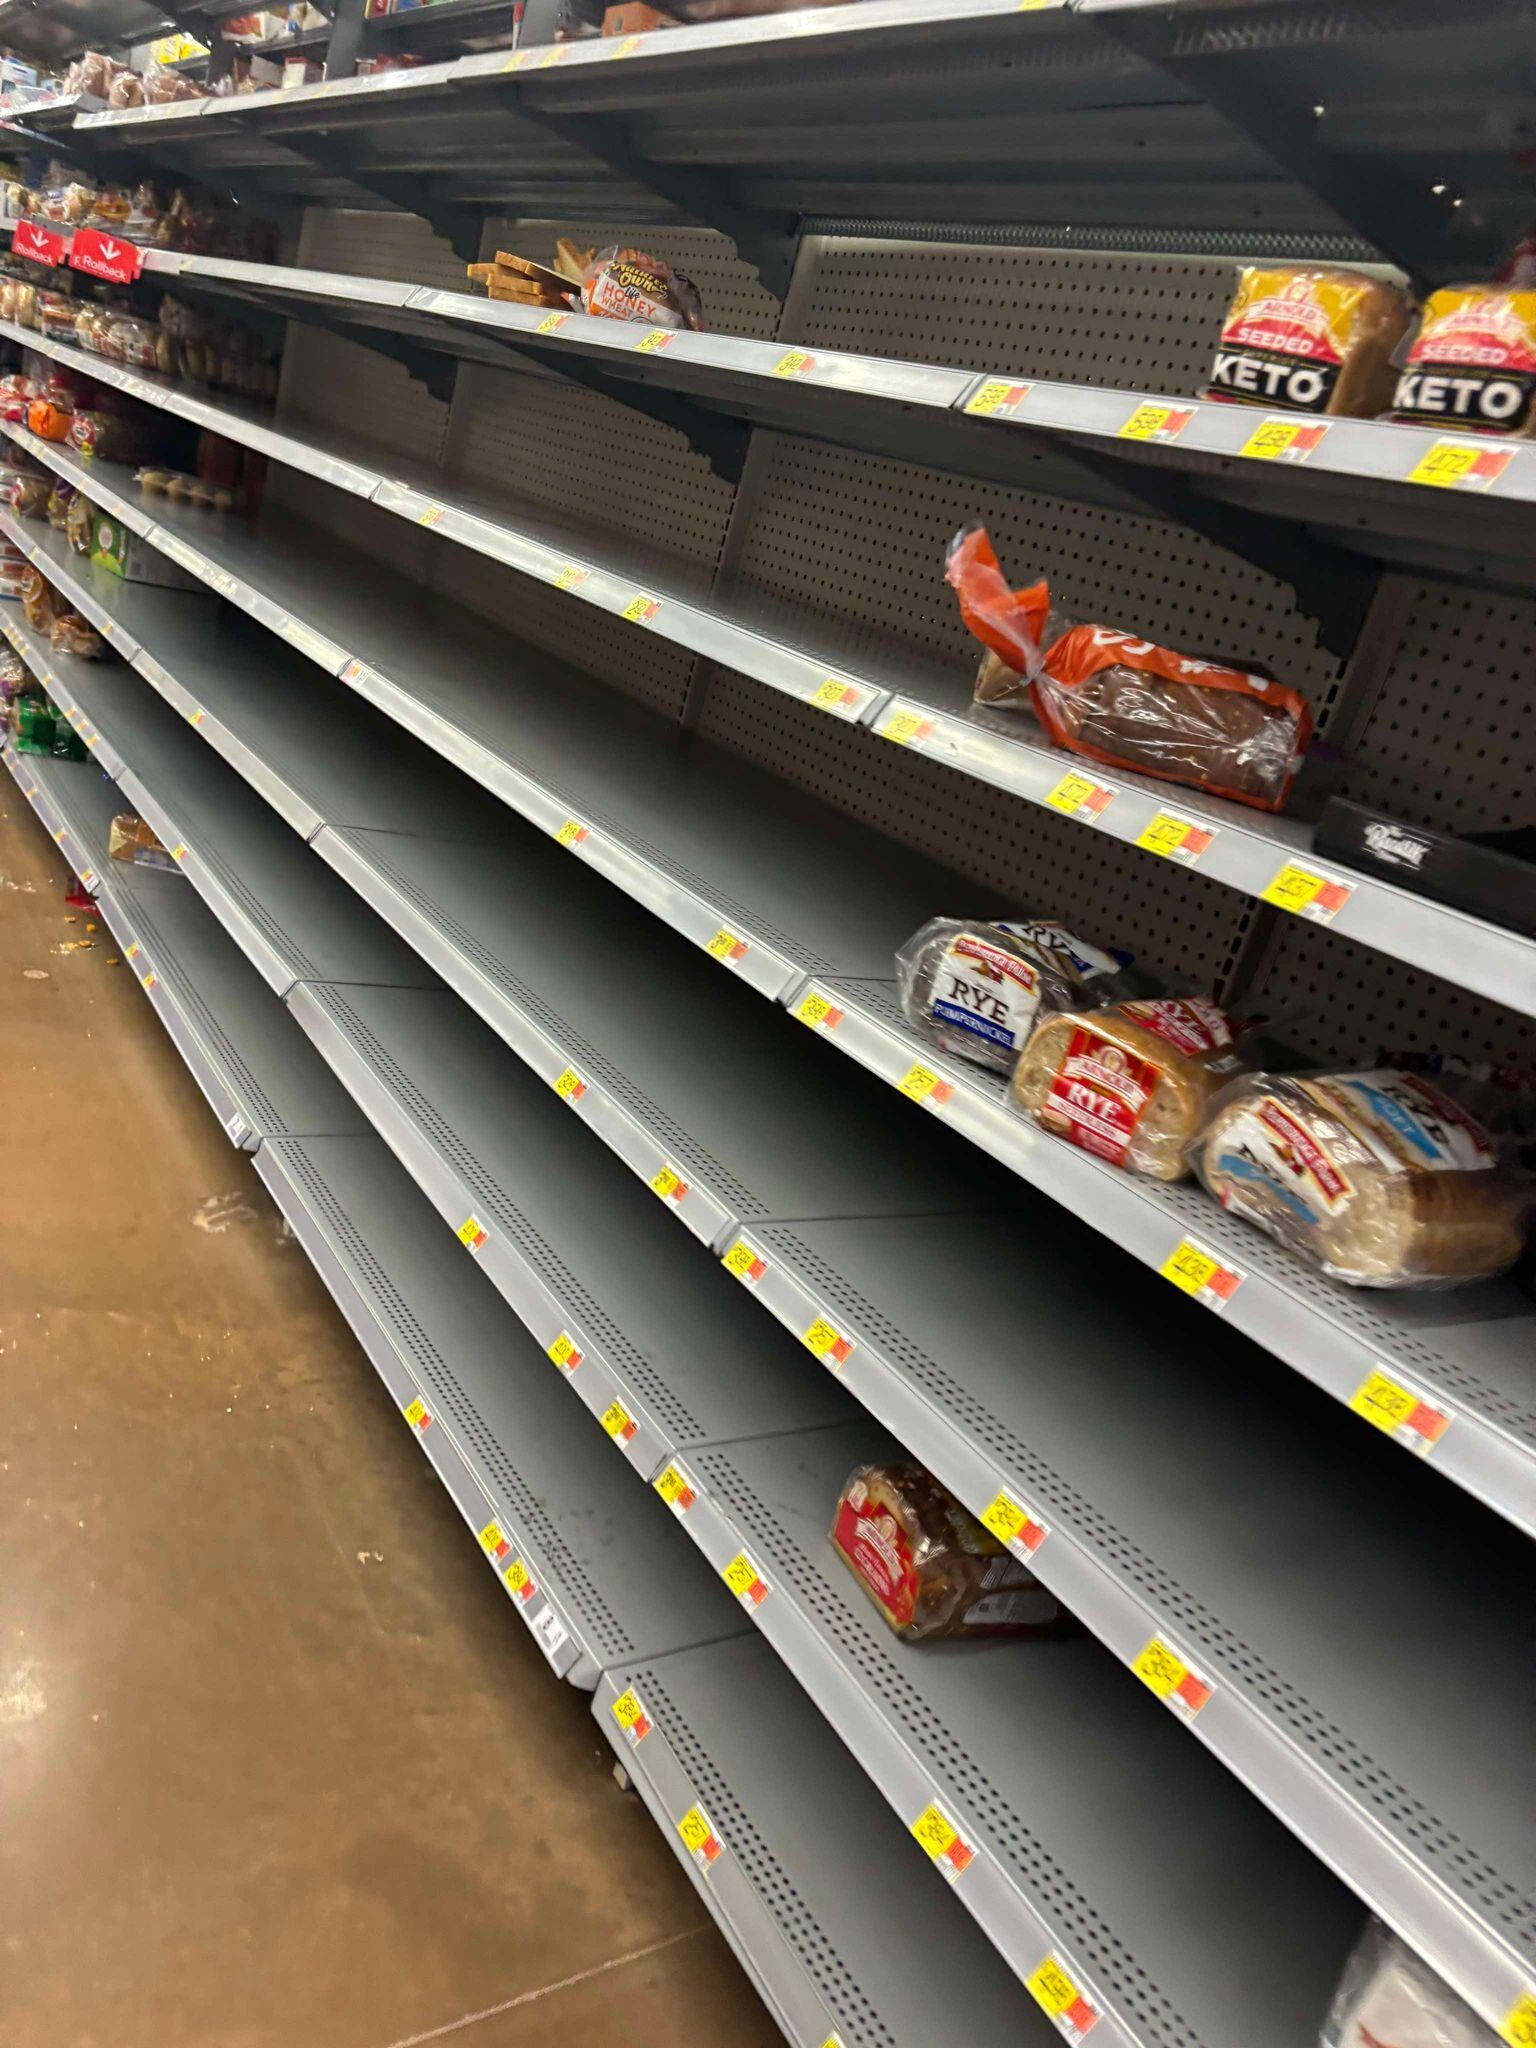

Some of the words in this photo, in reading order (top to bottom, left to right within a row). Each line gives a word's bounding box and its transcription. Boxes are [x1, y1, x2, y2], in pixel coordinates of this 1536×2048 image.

[15, 243, 53, 264] Rollback
[83, 255, 127, 281] Rollback
[601, 295, 633, 318] WHEAT
[603, 281, 656, 318] HONEY
[1238, 327, 1314, 354] SEEDED
[1420, 343, 1510, 366] SEEDED
[1210, 353, 1325, 404] KETO
[1392, 372, 1523, 419] KETO
[946, 979, 1010, 1025] RYE
[1066, 1082, 1122, 1121] RYE
